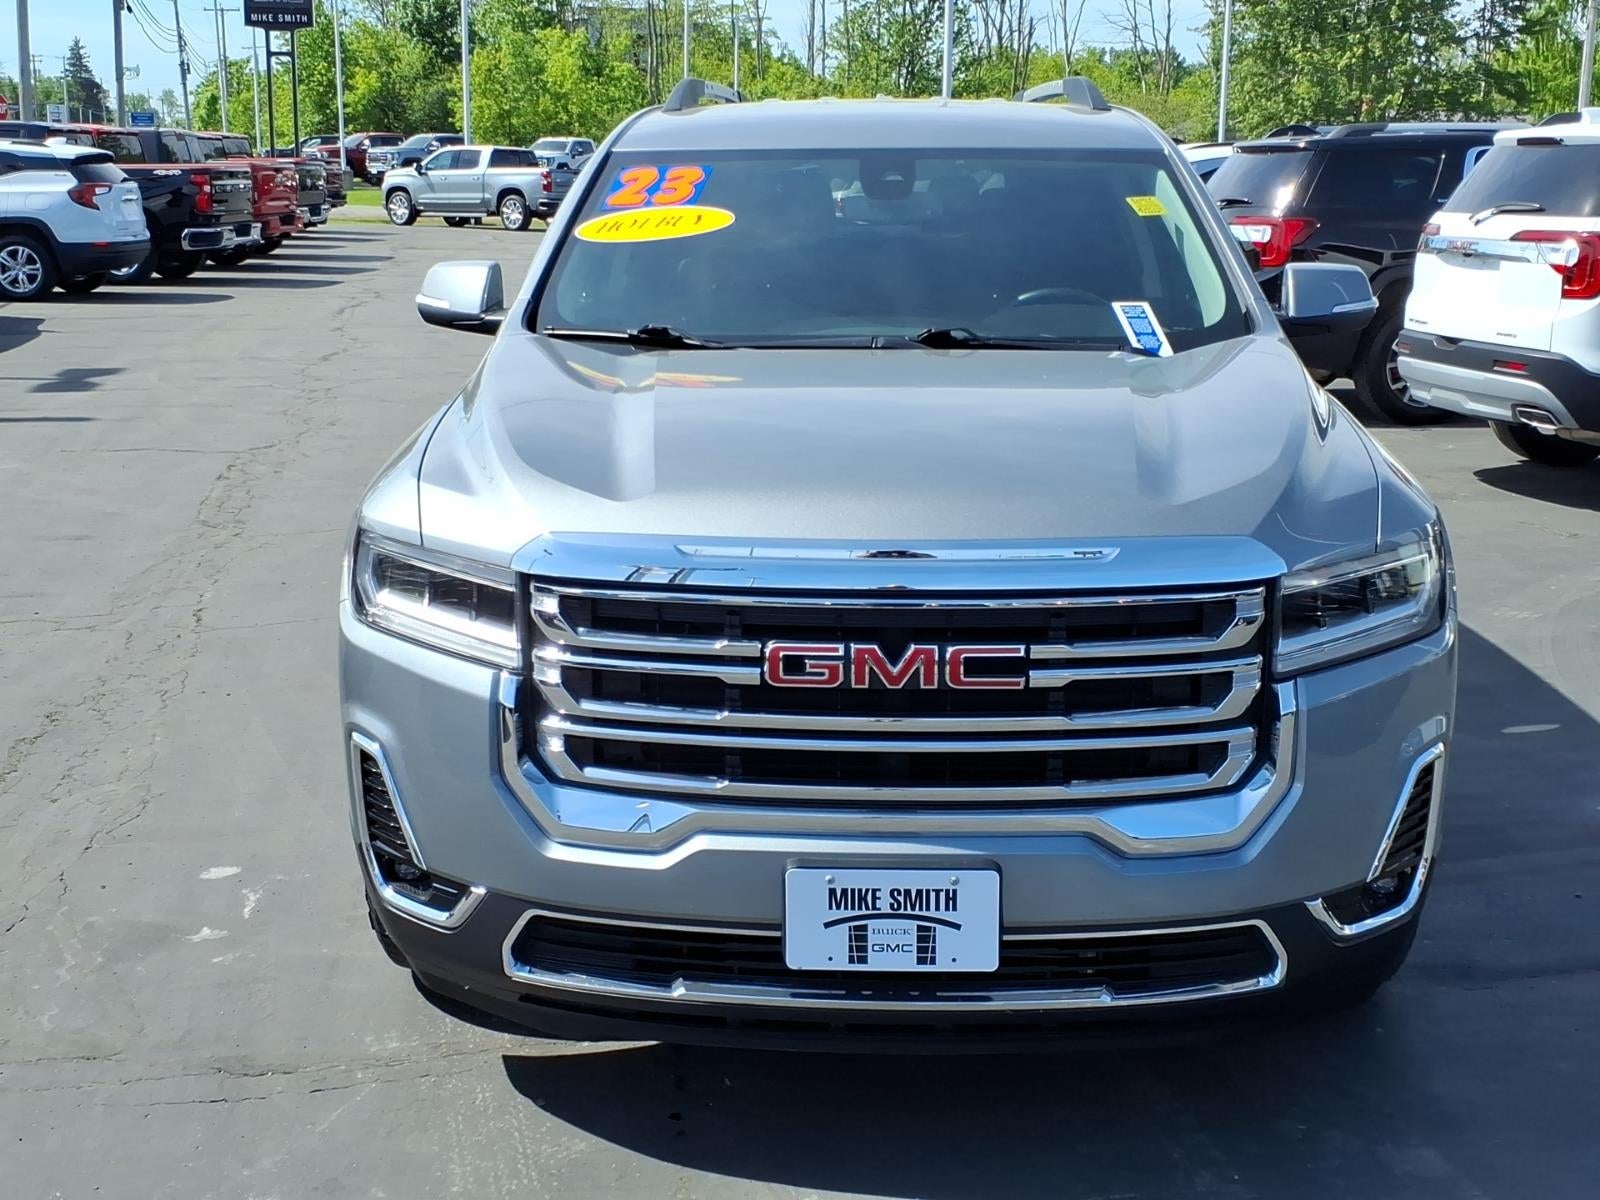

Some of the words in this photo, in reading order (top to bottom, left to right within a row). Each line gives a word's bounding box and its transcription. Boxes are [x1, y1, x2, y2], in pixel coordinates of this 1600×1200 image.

[250, 13, 274, 22] MIKE
[278, 14, 308, 23] SMITH
[606, 165, 706, 208] 23
[764, 640, 1026, 690] GMC
[827, 887, 882, 912] MIKE
[888, 887, 958, 913] SMITH
[871, 927, 913, 936] BUICK
[871, 943, 914, 953] GMC
